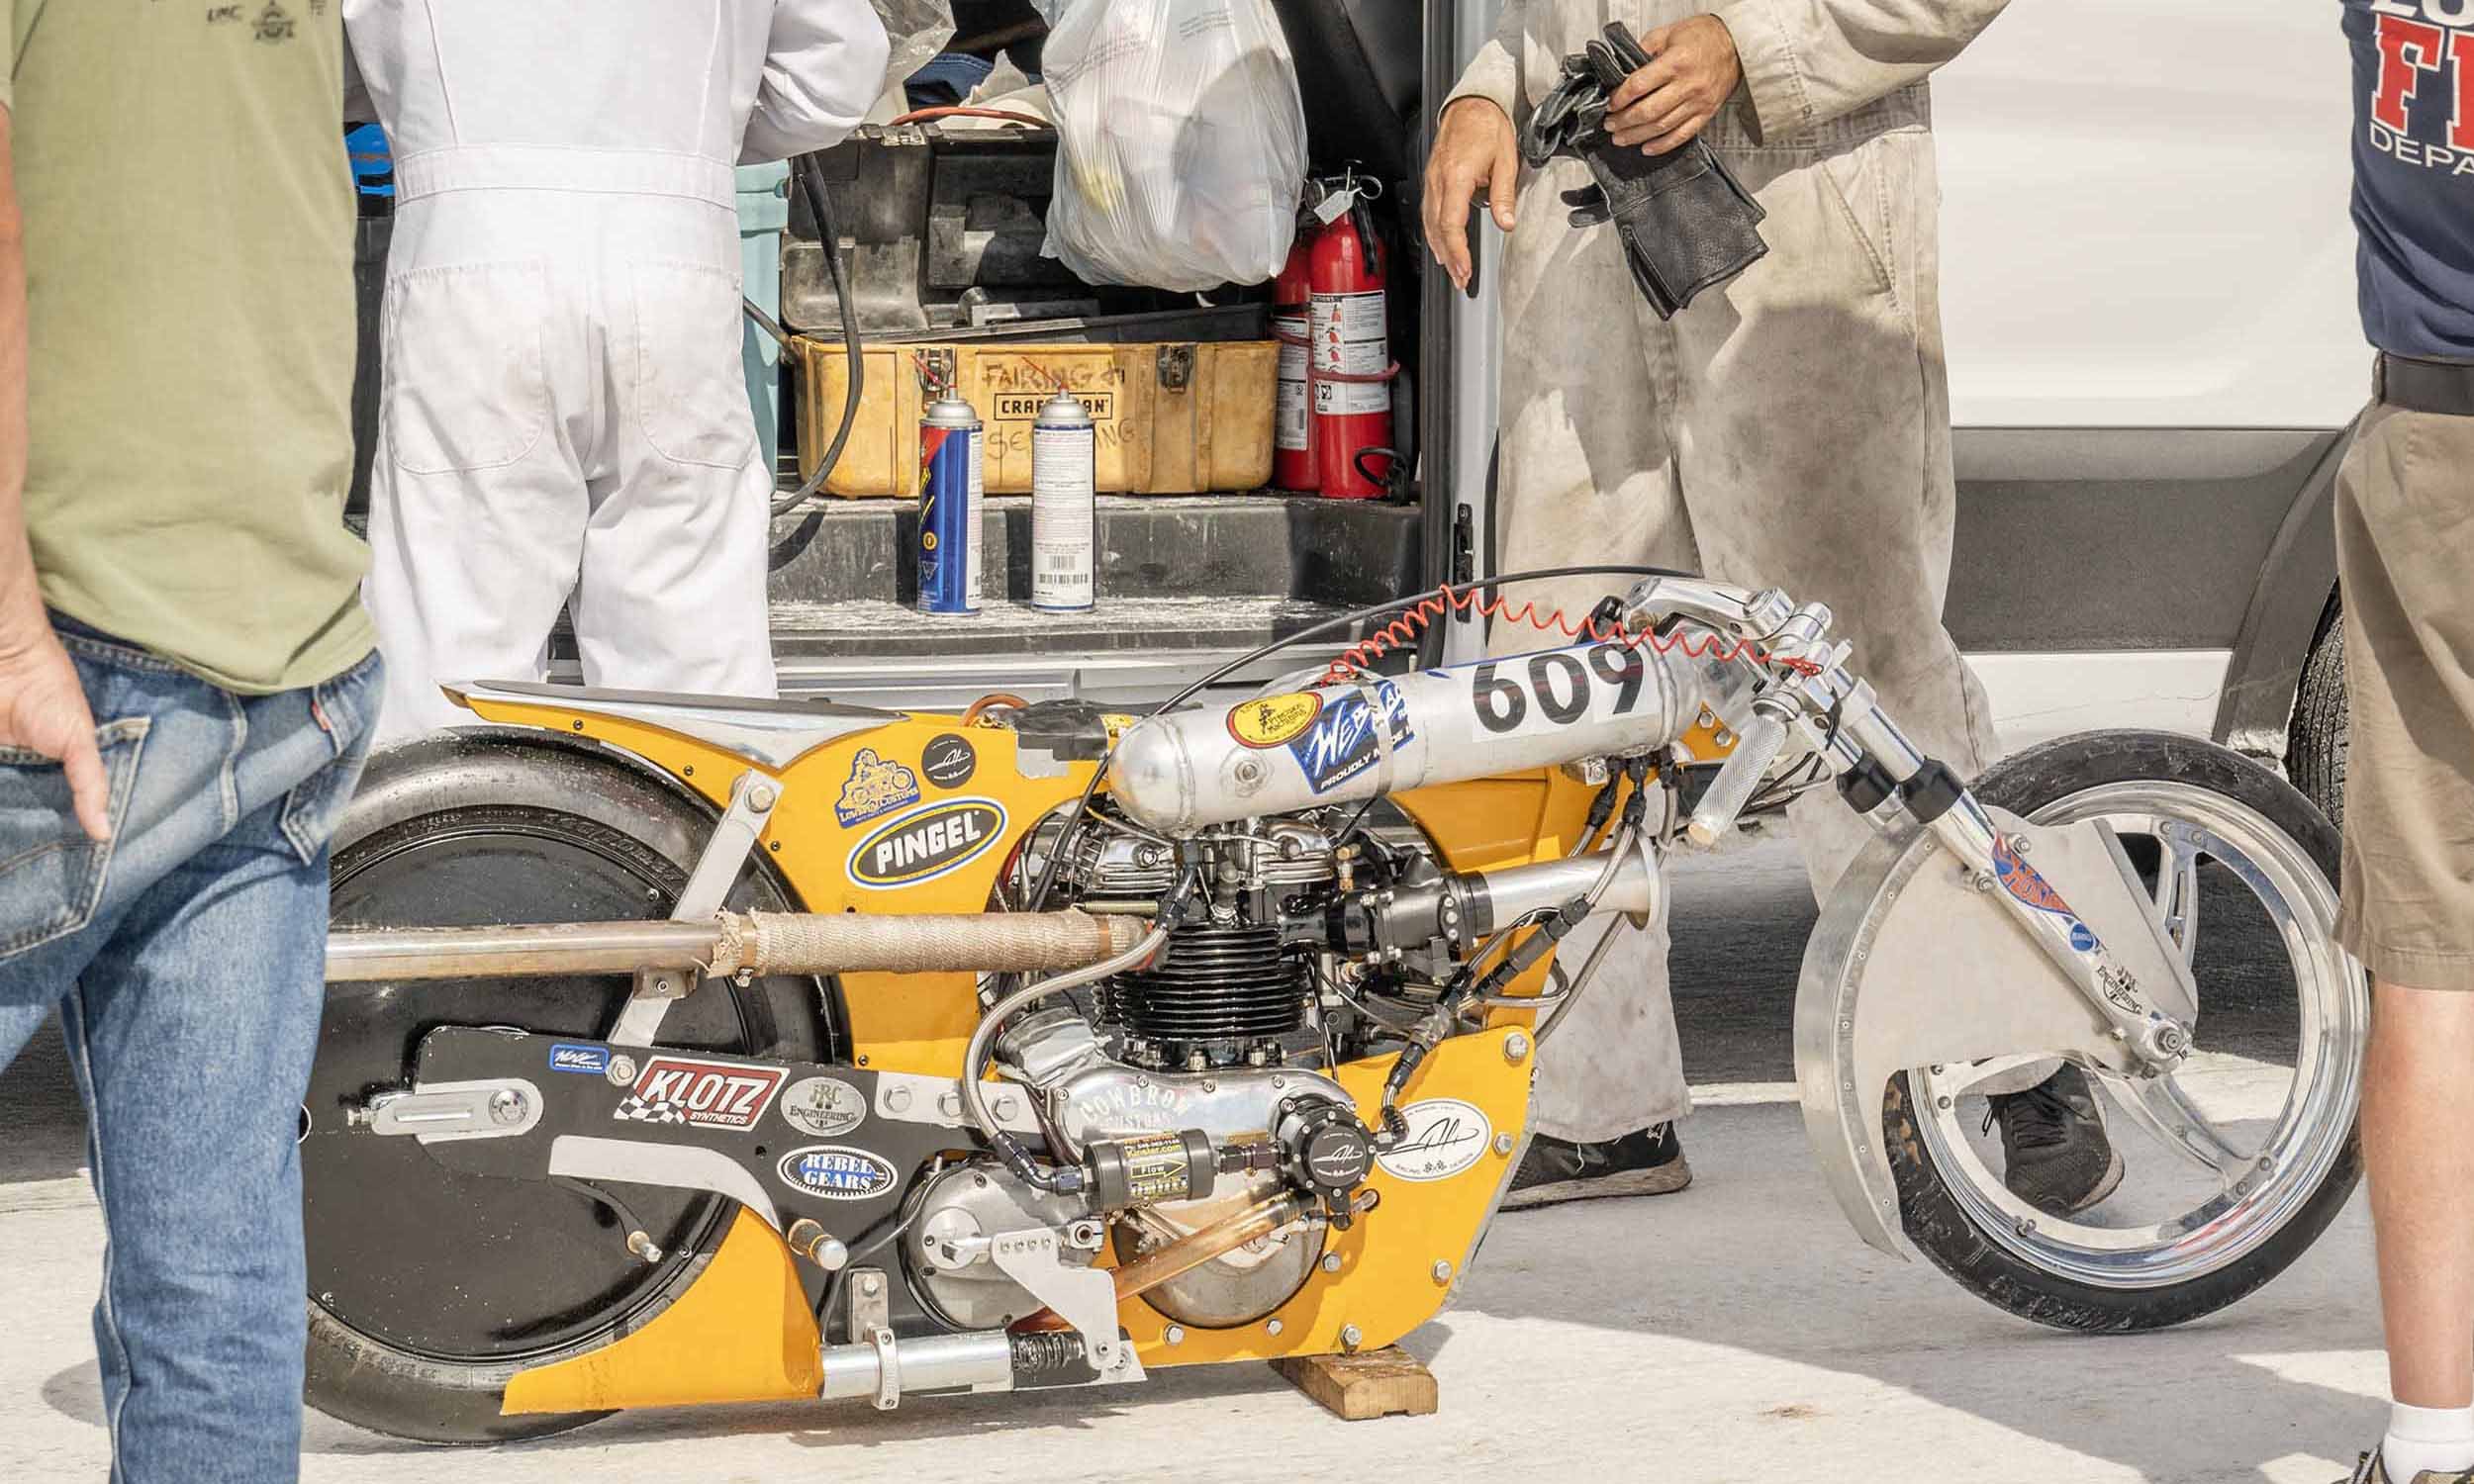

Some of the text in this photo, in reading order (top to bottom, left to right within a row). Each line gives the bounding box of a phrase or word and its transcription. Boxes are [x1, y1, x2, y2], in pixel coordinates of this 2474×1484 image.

[1001, 398, 1106, 415] CRAFAN
[1474, 642, 1644, 733] 609
[1320, 752, 1372, 789] PROUDLY
[876, 811, 982, 876] PINGEL
[641, 1068, 770, 1115] KLOTZ
[690, 1110, 748, 1125] SYNTHETICS
[789, 1104, 859, 1123] ENGINEERING
[807, 1154, 874, 1174] REBEL
[1141, 1165, 1165, 1174] Flow
[803, 1170, 872, 1190] GEARS
